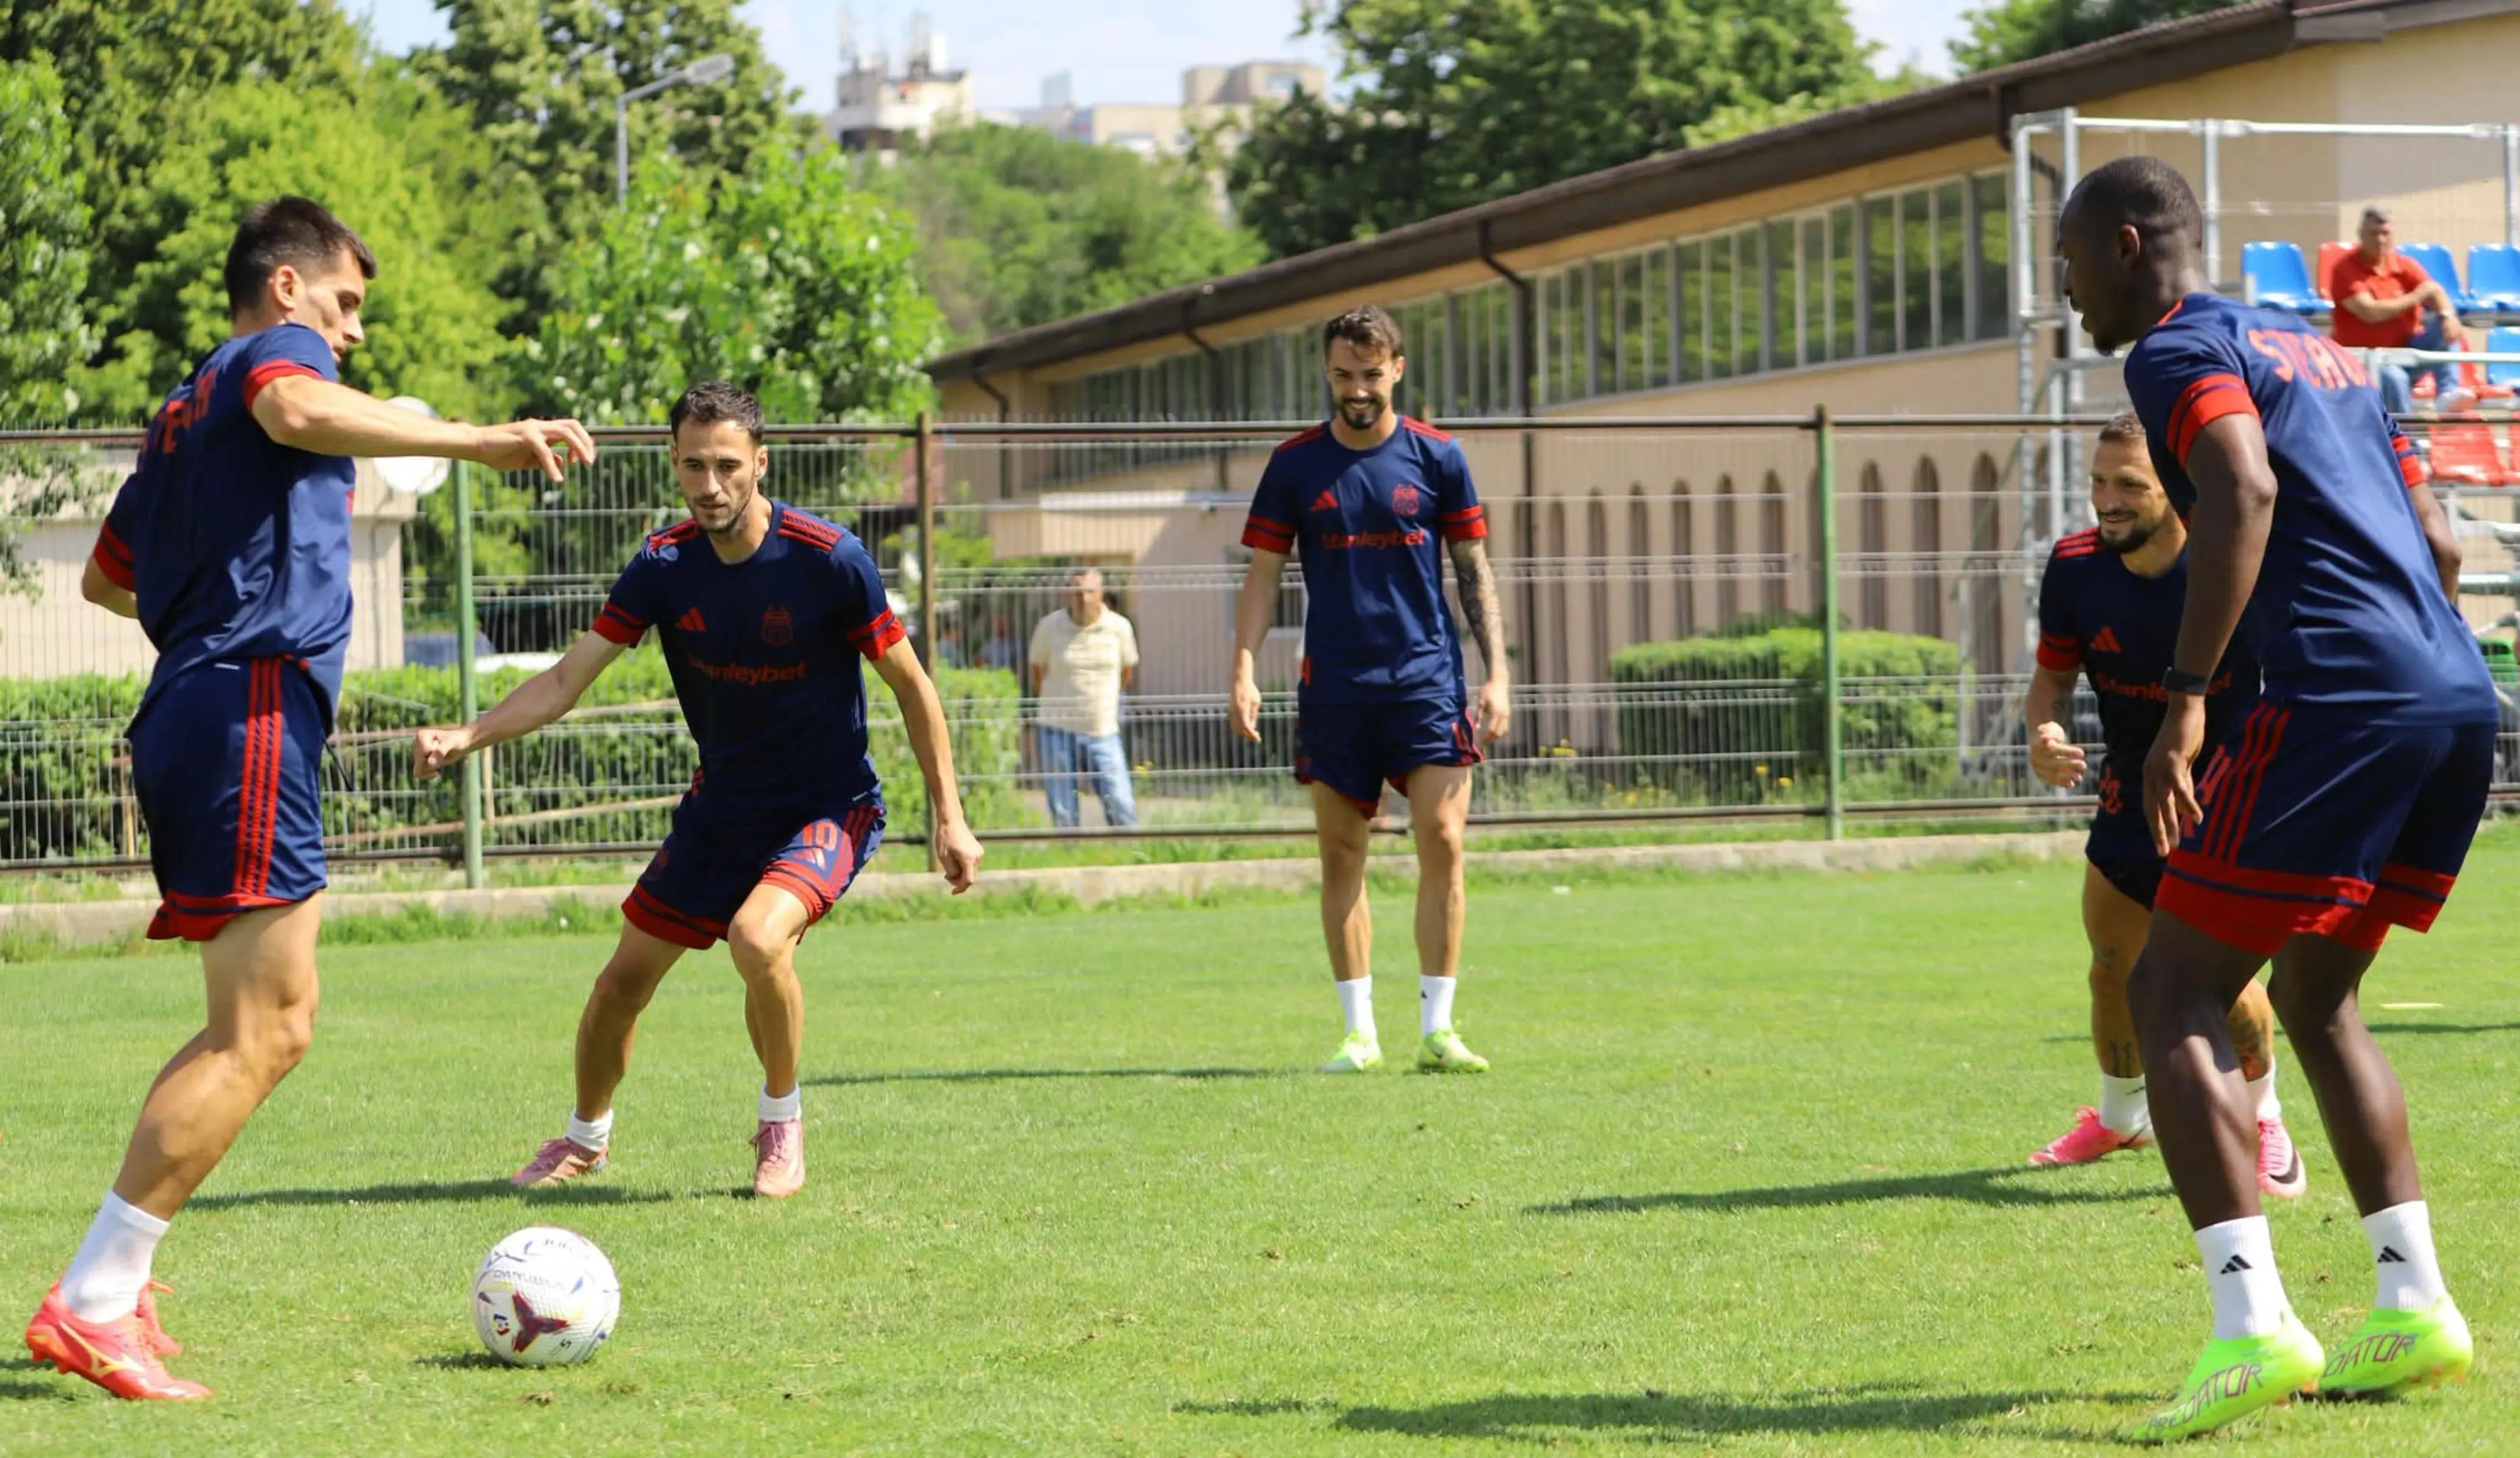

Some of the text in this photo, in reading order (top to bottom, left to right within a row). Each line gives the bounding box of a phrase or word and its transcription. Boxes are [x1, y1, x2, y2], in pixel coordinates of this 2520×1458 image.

[2248, 328, 2377, 389] STEAU
[803, 821, 838, 850] 10
[2322, 1331, 2419, 1378] DATOR
